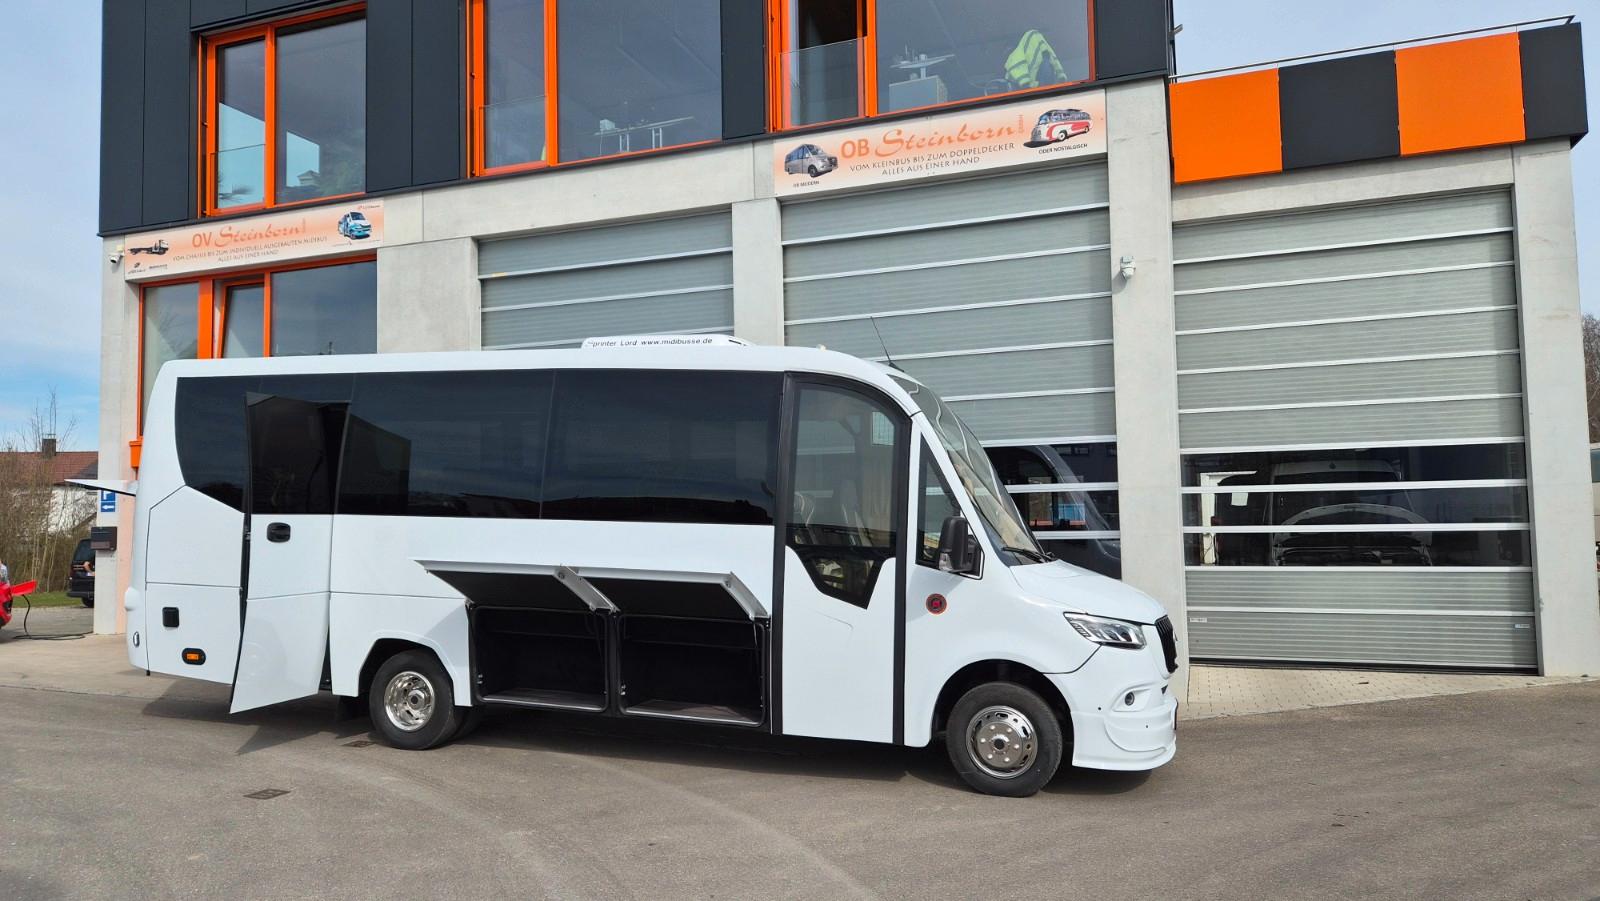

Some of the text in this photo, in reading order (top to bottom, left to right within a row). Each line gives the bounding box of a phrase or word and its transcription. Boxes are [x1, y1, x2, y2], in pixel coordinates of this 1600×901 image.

[841, 123, 1016, 159] OB Steinborn
[850, 142, 1015, 172] VOM KLEINBUS BIS ZUM DOPPELDECKER
[882, 156, 980, 176] ALLES AUS EINER HAND
[192, 231, 212, 248] OV
[214, 223, 301, 248] Steinborn
[641, 337, 713, 346] www.midibusse.de
